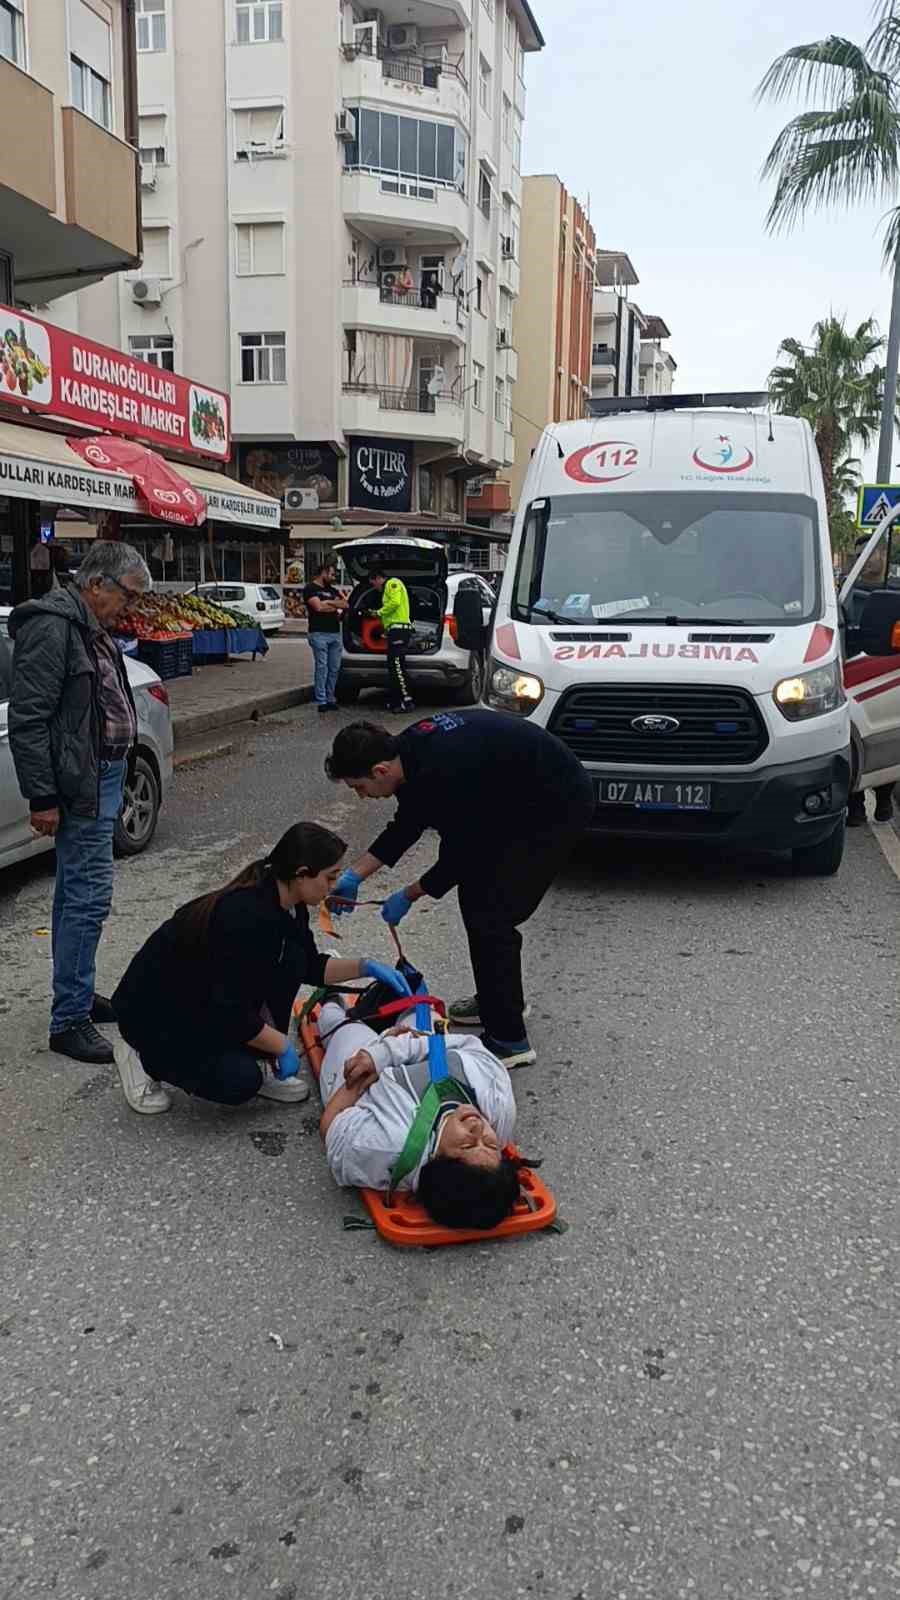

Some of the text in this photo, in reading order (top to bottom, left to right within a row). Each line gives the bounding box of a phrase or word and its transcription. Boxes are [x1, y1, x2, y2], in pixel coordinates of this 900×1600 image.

[72, 346, 176, 405] DURANOĞULLARI
[60, 376, 186, 437] KARDEŞLER MARKET
[597, 449, 638, 468] 112
[47, 471, 112, 496] KARDEŞLER
[160, 509, 185, 522] ALGIDA
[220, 498, 255, 514] KARDEŞLER
[255, 505, 277, 519] MARKET
[607, 782, 704, 803] 07 AAT 112
